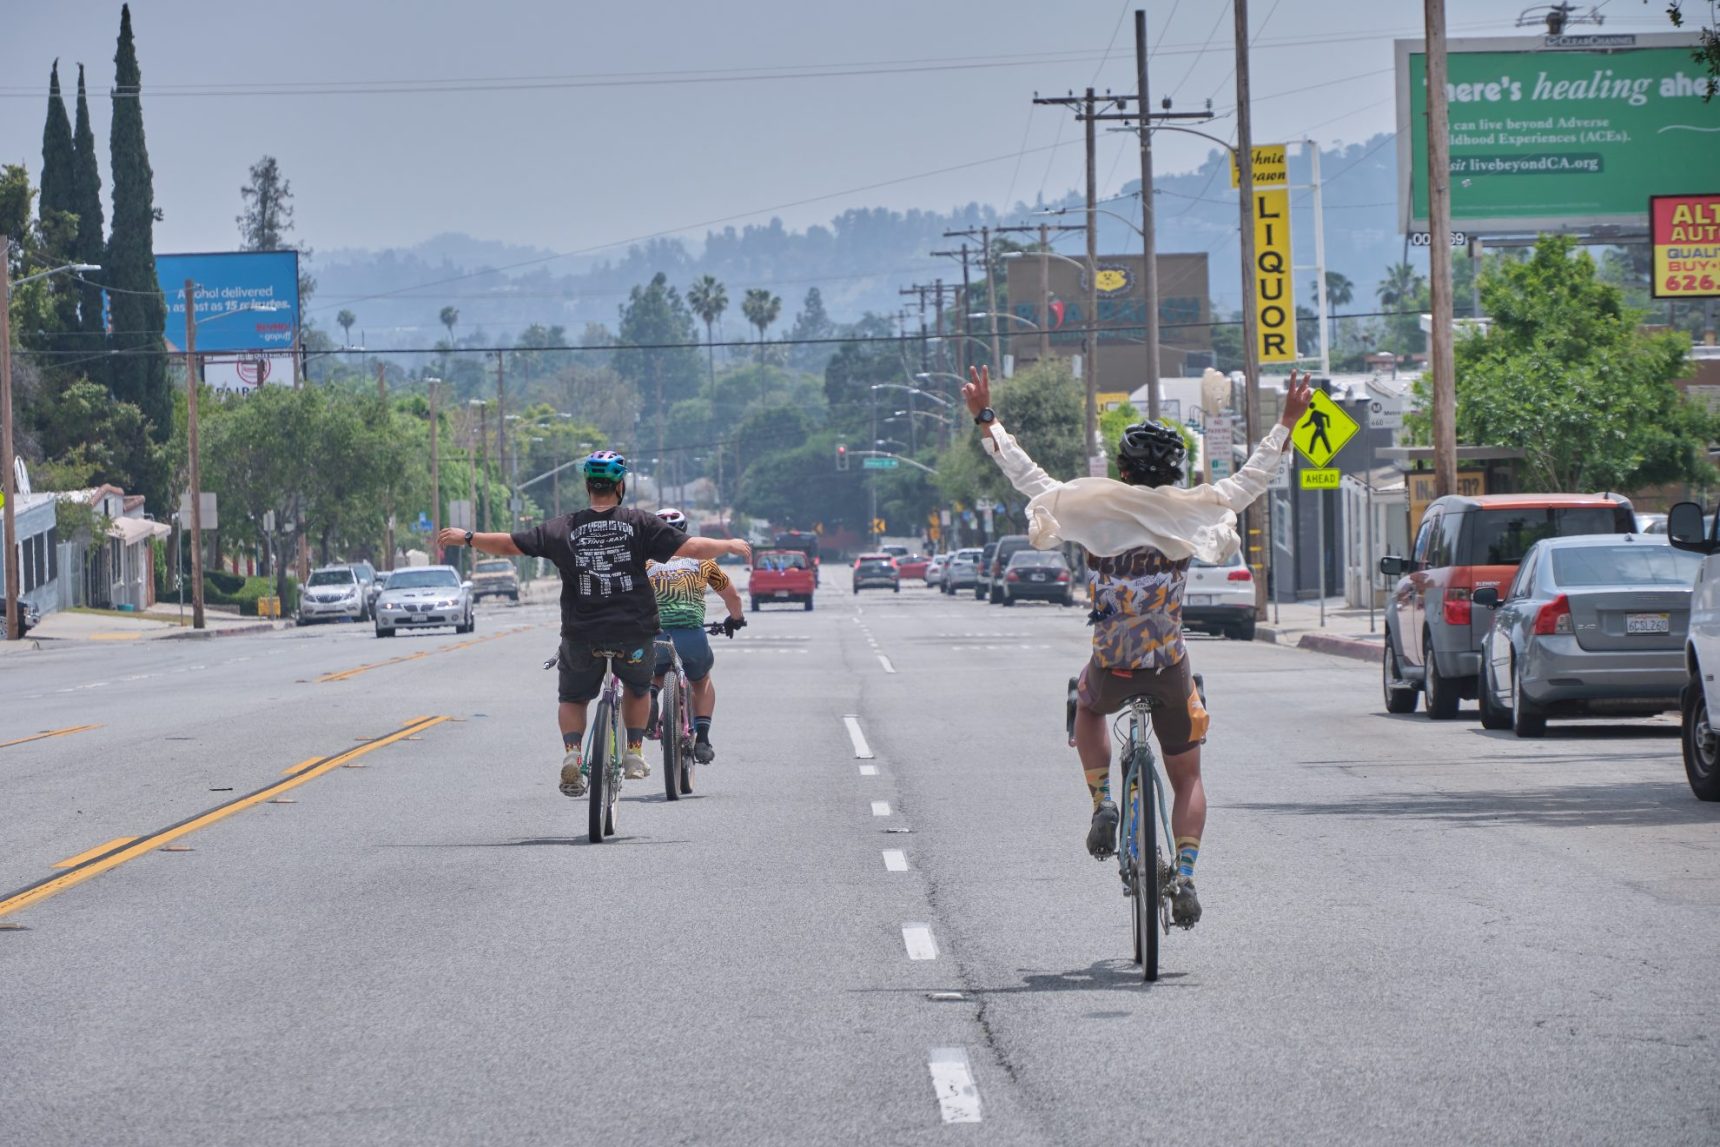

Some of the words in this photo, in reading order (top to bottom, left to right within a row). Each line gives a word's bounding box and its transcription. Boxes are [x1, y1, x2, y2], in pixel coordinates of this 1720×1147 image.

[1532, 69, 1653, 106] healing
[1659, 71, 1720, 97] ahe
[1453, 120, 1476, 131] can
[1480, 118, 1503, 130] live
[1506, 117, 1553, 132] beyond
[1557, 116, 1609, 128] Adverse
[1499, 132, 1577, 147] Experiences
[1470, 156, 1599, 174] livebeyondCA.org
[1670, 226, 1720, 241] AUT
[1258, 196, 1287, 356] LIQUOR
[221, 285, 273, 299] delivered
[1305, 474, 1337, 485] AHEAD
